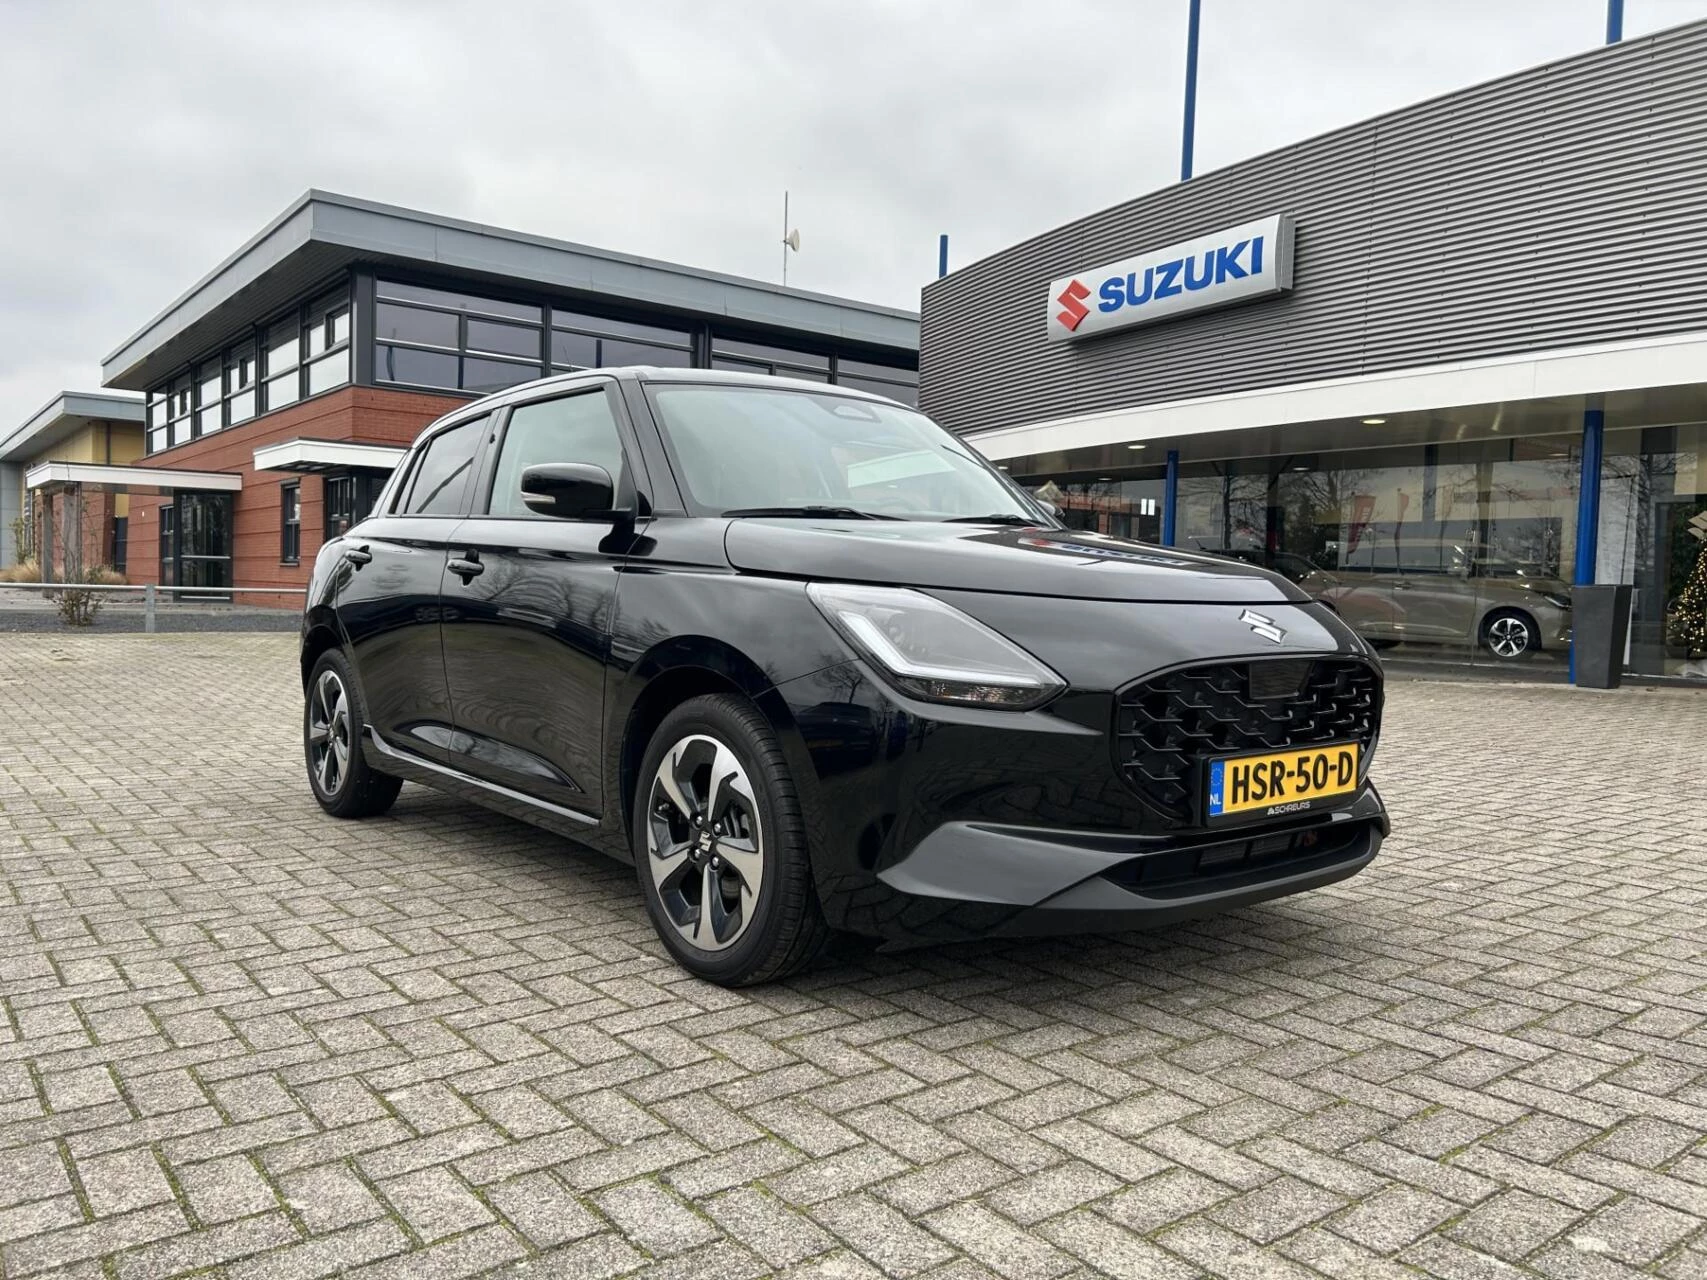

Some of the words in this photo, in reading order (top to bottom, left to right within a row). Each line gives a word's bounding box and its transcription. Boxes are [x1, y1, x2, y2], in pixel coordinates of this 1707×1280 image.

[1098, 236, 1264, 313] SUZUKI
[1209, 793, 1221, 805] NL
[1232, 751, 1353, 804] HSR-50-D
